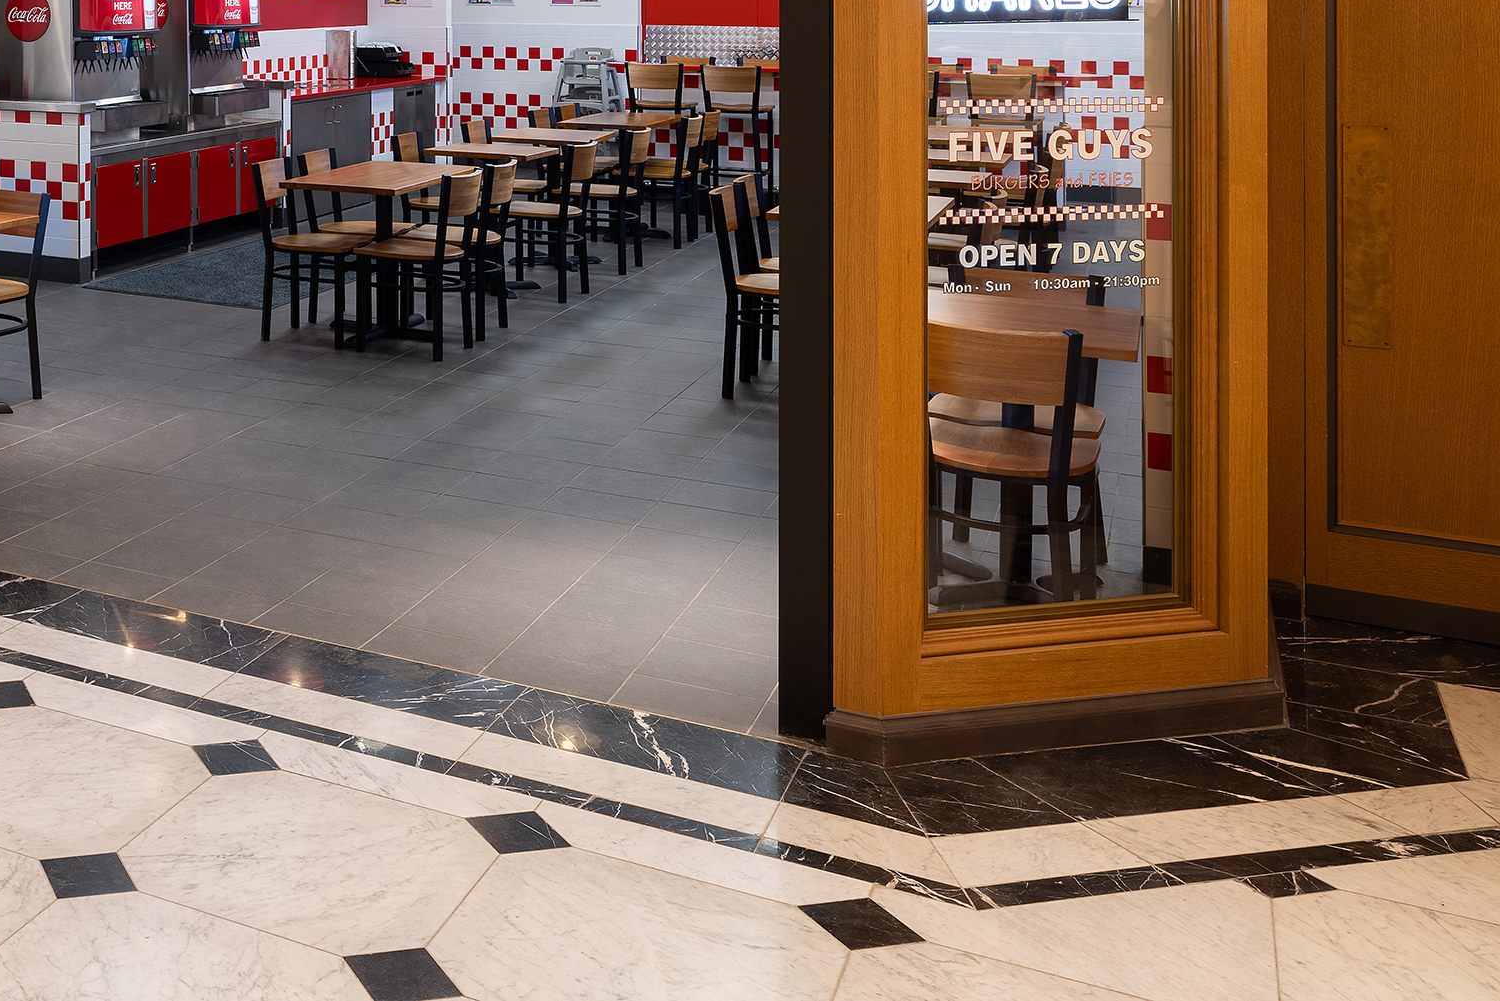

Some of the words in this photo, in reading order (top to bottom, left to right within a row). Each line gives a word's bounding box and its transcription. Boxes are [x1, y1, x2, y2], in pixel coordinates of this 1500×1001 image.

[8, 6, 49, 23] Coca-Cola
[114, 1, 133, 11] HERE
[948, 130, 1034, 163] FIVE
[1048, 128, 1154, 161] GUYS
[971, 174, 1050, 191] BURGERS
[1055, 173, 1083, 189] and
[1088, 171, 1134, 188] FRIES
[958, 243, 1037, 268] OPEN
[1047, 243, 1063, 265] 7
[1072, 239, 1146, 264] DAYS
[943, 281, 972, 294] Mon
[985, 281, 1011, 293] Sun
[1032, 278, 1091, 291] 10:30am
[1103, 276, 1161, 289] 21:30pm
